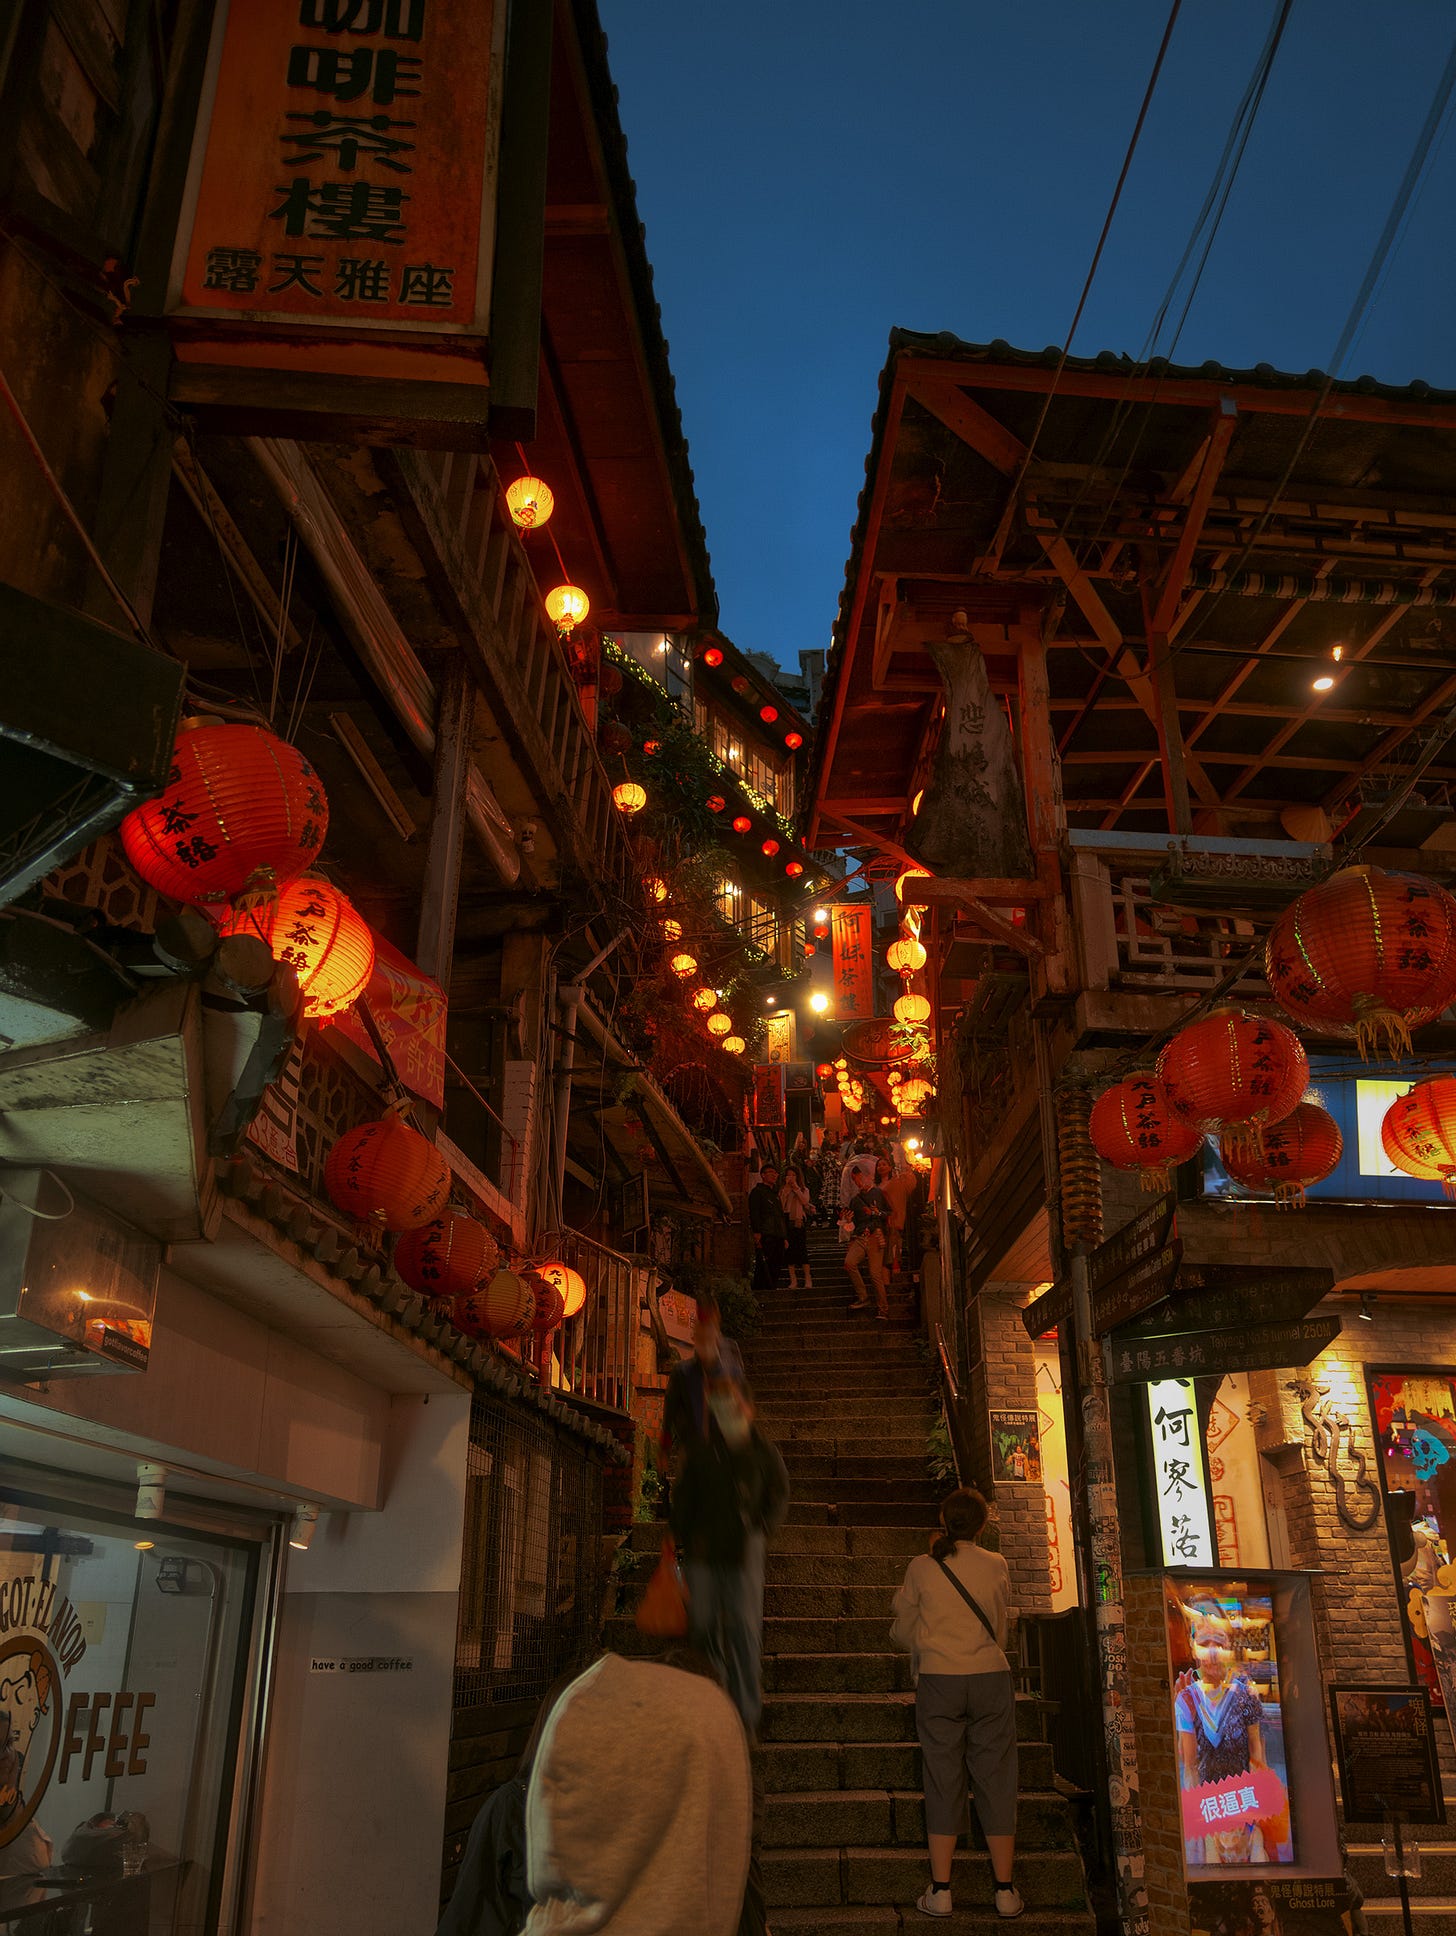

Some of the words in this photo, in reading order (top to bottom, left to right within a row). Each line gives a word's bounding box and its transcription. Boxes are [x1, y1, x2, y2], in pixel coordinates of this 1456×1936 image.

[203, 246, 455, 309] 露天雅座
[1303, 1321, 1332, 1340] 250M
[1119, 1344, 1207, 1373] 臺陽五番坑
[311, 1659, 335, 1670] have
[339, 1662, 346, 1670] a
[349, 1659, 374, 1672] good
[377, 1658, 413, 1670] coffee
[1199, 1785, 1260, 1825] 很逼真
[1288, 1897, 1315, 1909] Ghost
[1316, 1897, 1336, 1909] Lore
